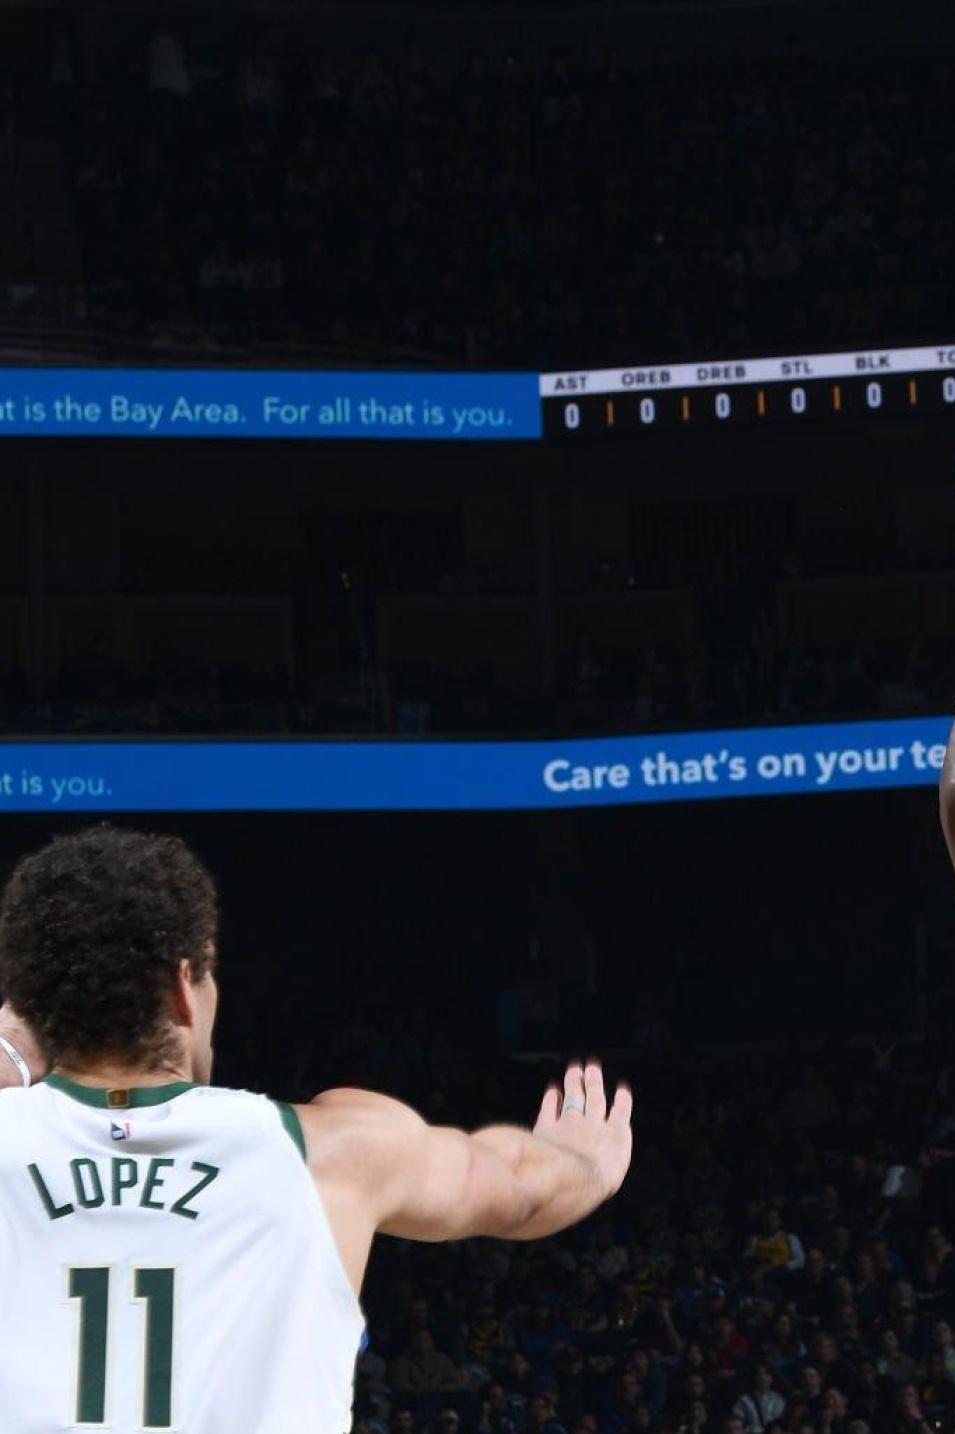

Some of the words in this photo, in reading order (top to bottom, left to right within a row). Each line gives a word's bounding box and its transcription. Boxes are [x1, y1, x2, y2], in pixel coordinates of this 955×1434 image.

[554, 375, 588, 390] AST
[621, 370, 671, 386] OREB
[697, 365, 747, 381] DREB
[781, 360, 813, 376] STL
[855, 355, 891, 370] BLK
[0, 398, 14, 422] t
[24, 396, 46, 422] is
[53, 393, 101, 423] the
[111, 395, 163, 430] Bay
[170, 396, 247, 423] Area.
[263, 396, 310, 425] For
[318, 397, 350, 425] all
[359, 397, 414, 425] that
[422, 399, 445, 425] is
[452, 405, 513, 434] you.
[564, 403, 580, 428] 0
[640, 398, 656, 424] 0
[715, 392, 731, 418] 0
[790, 387, 806, 414] 0
[867, 382, 882, 408] 0
[0, 773, 12, 795] t
[21, 769, 43, 795] is
[50, 776, 112, 803] you.
[543, 759, 630, 792] Care
[640, 749, 747, 786] that's
[757, 752, 806, 779] on
[815, 747, 904, 785] your
[910, 740, 948, 770] te
[27, 1157, 219, 1220] LOPEZ
[66, 1265, 177, 1430] 11
